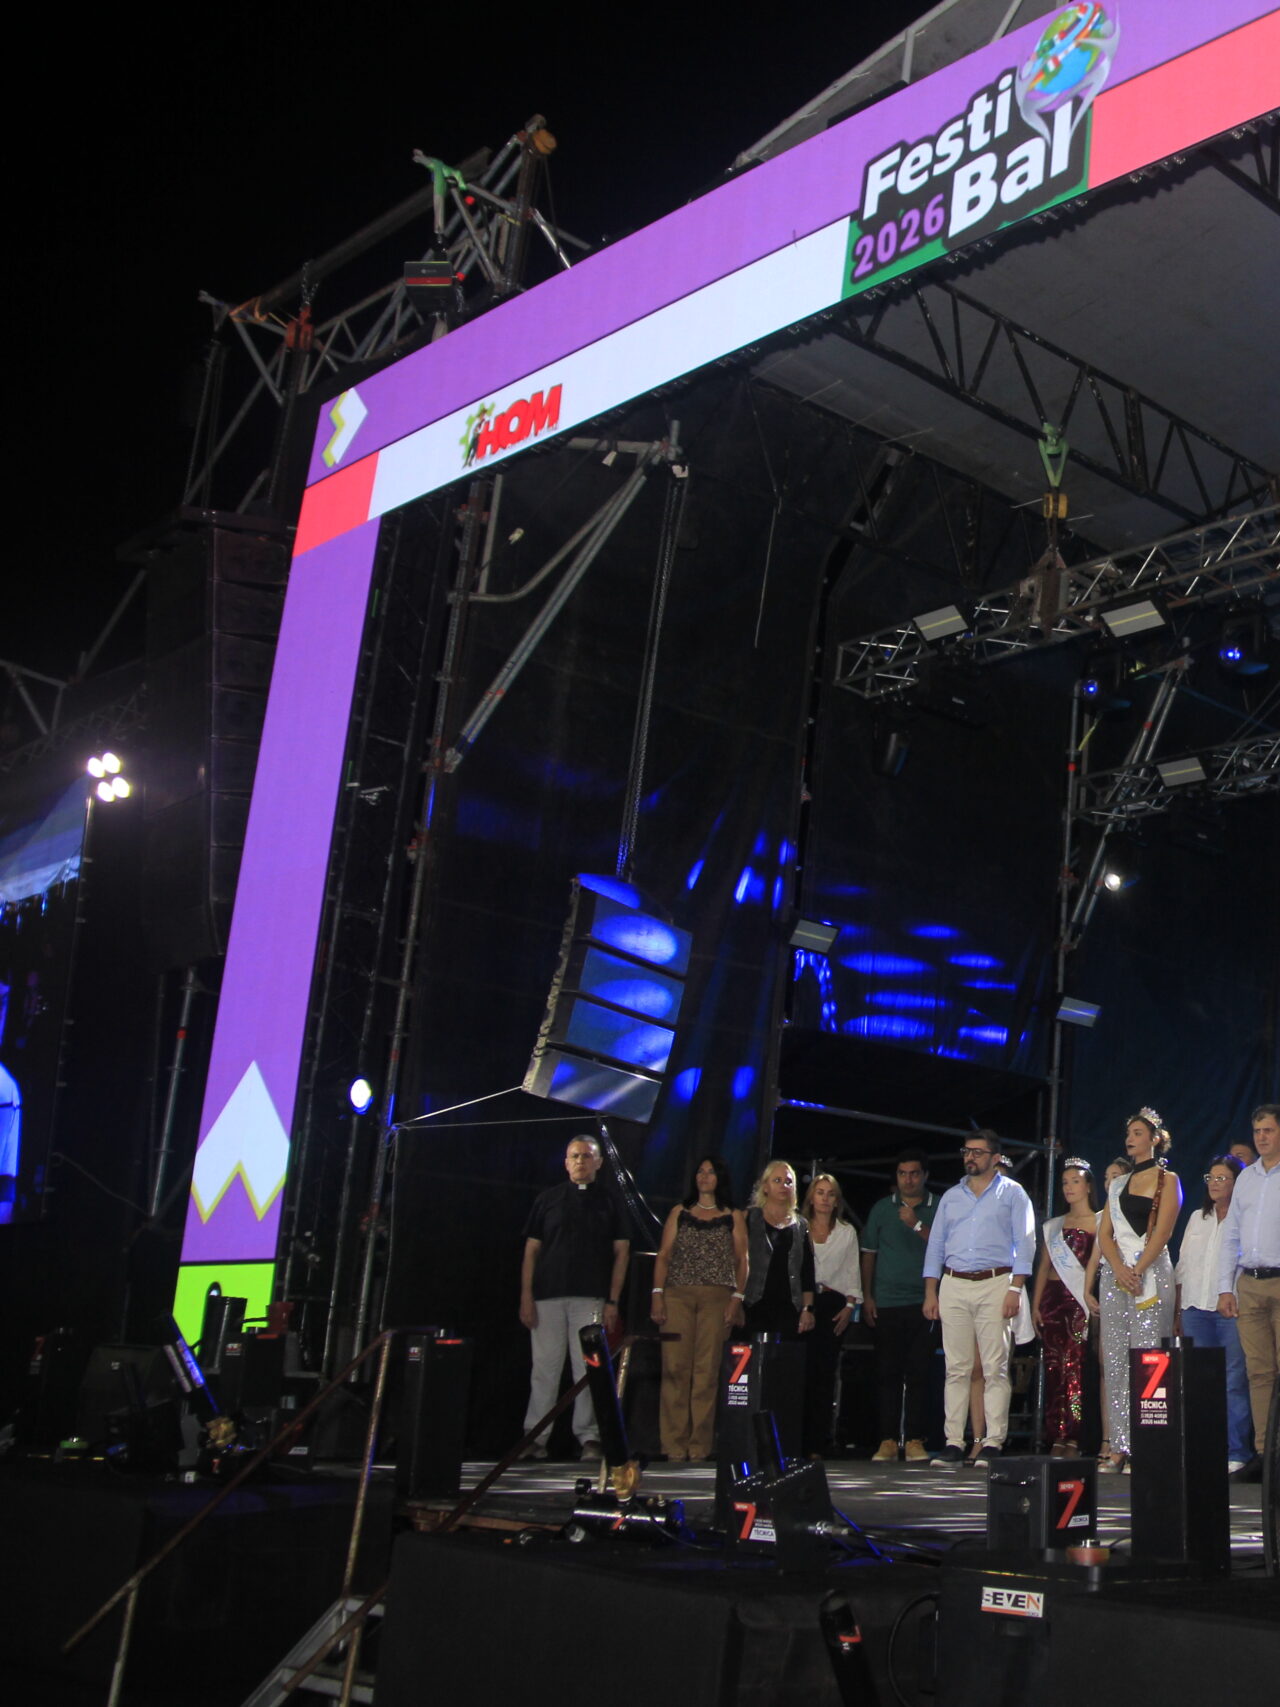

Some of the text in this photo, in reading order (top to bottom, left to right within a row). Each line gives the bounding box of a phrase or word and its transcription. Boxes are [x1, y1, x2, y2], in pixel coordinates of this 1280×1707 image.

[862, 72, 1014, 221] Festi
[948, 99, 1073, 239] Bal
[853, 193, 946, 279] 2026
[475, 382, 563, 460] HOM
[729, 1345, 752, 1384] 7
[1141, 1352, 1170, 1399] 7
[1140, 1400, 1168, 1410] TÉCNICA
[733, 1501, 756, 1539] 7
[1056, 1480, 1084, 1529] 7
[983, 1591, 1041, 1609] SEVEN
